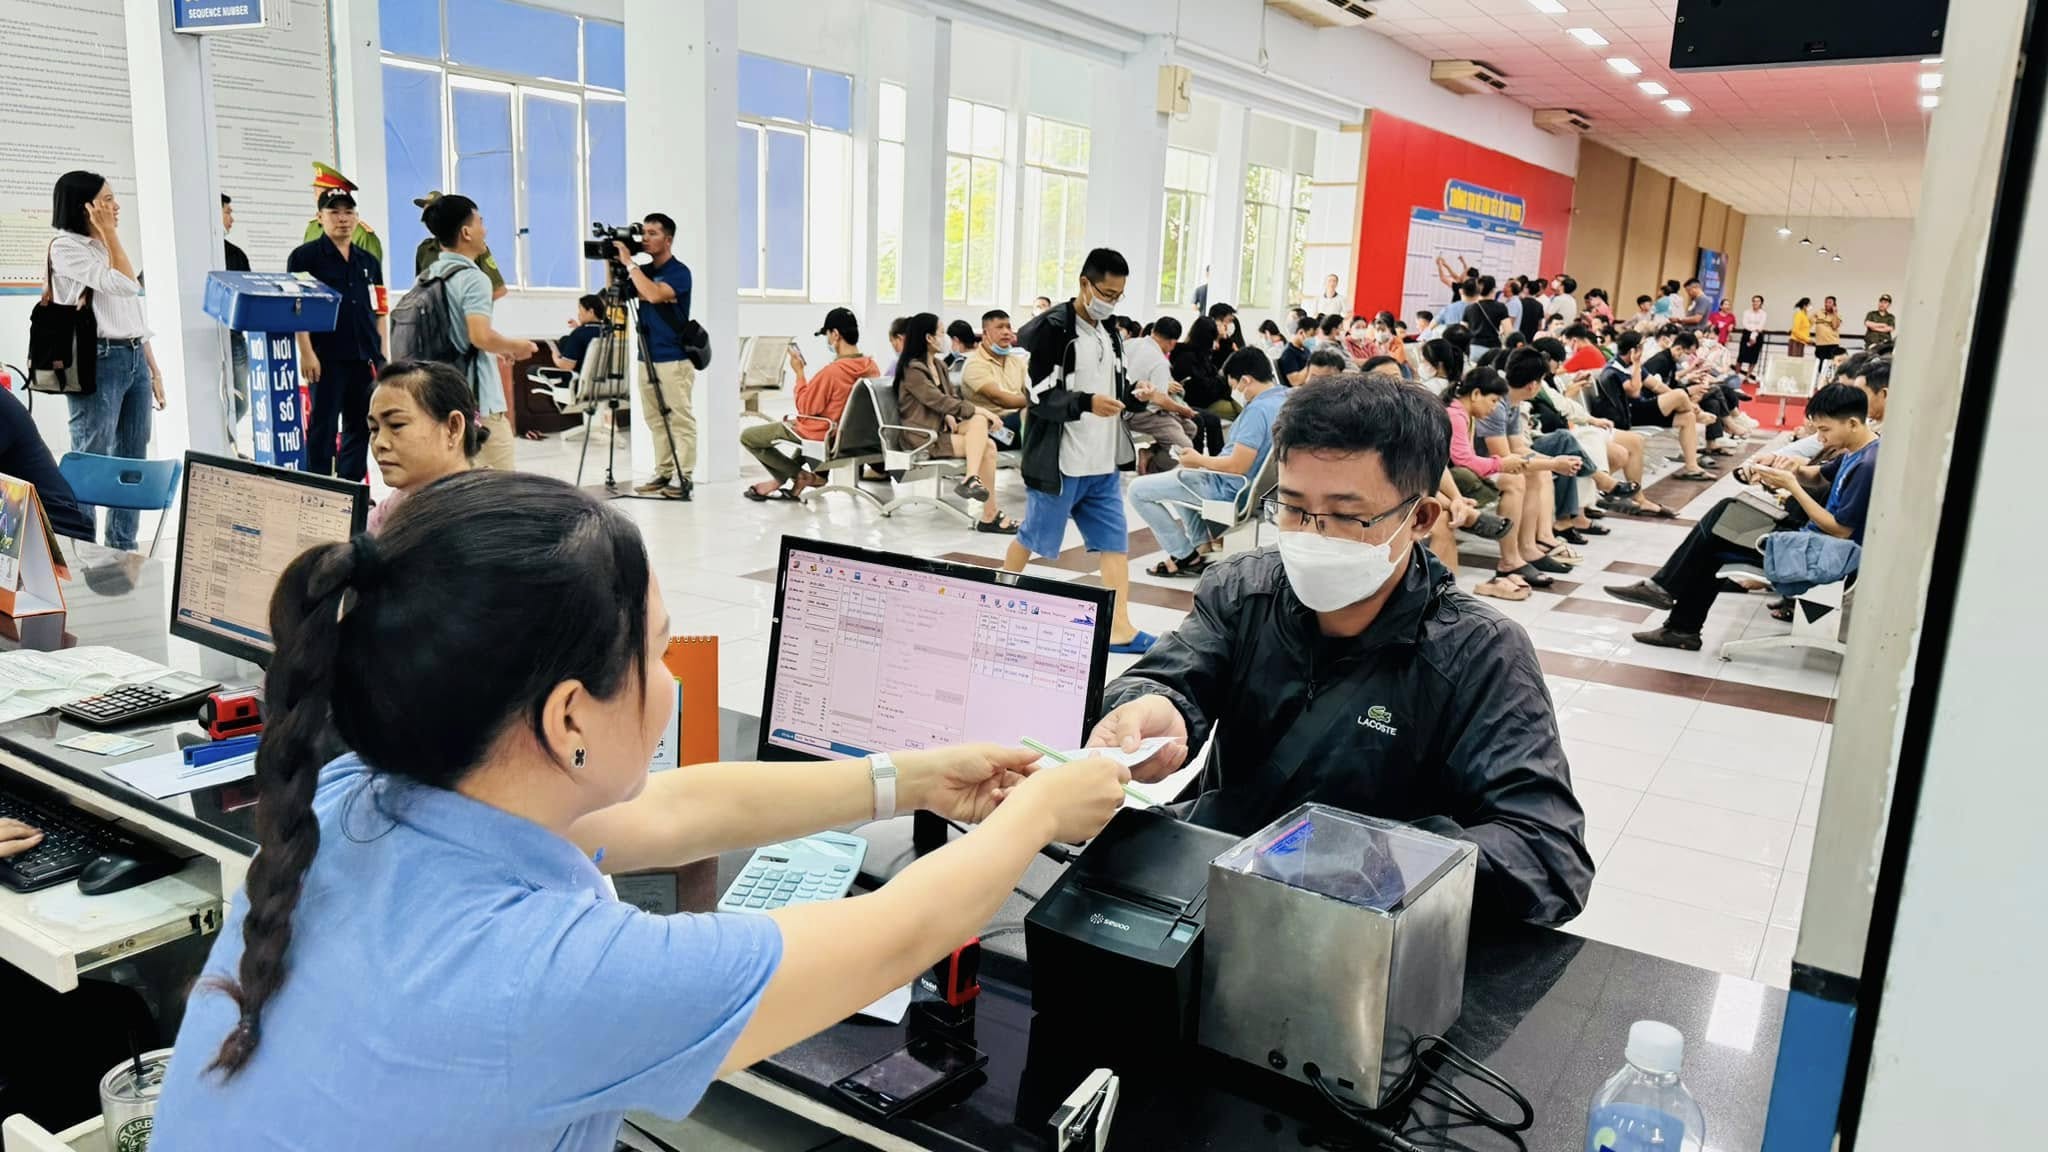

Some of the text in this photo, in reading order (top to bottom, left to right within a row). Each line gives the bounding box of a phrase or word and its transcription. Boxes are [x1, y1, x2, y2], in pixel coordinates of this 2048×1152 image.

[188, 5, 249, 19] SEQUENCE NUMBER
[272, 337, 292, 361] NƠI
[273, 363, 295, 391] LẤY
[279, 394, 295, 422] SỐ
[278, 427, 300, 452] THỨ
[1357, 715, 1397, 736] LACOSTE
[120, 1119, 153, 1144] STARB
